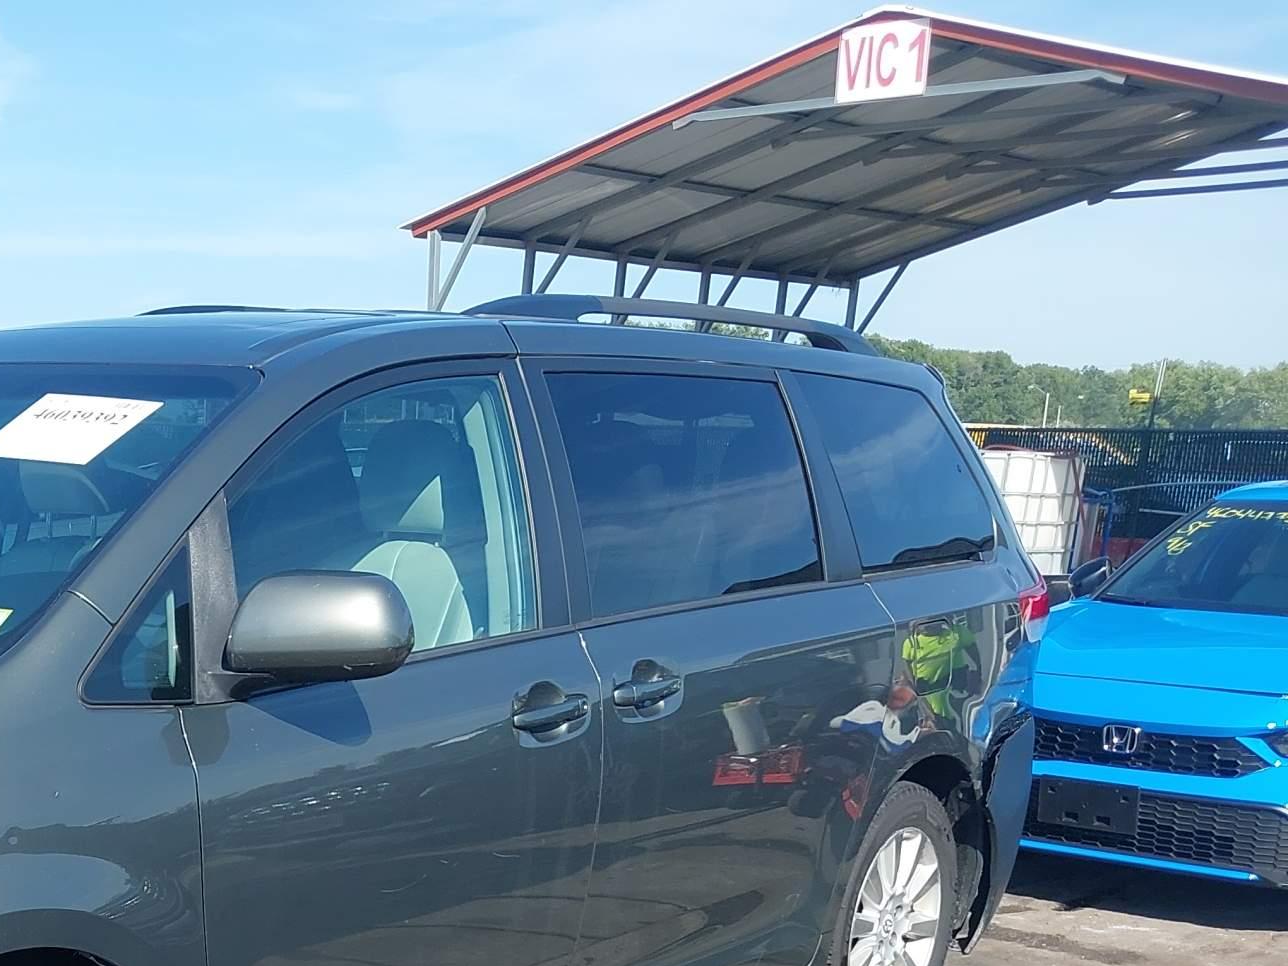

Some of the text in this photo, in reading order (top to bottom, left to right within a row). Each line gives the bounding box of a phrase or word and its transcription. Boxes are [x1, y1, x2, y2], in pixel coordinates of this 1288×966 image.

[842, 28, 928, 91] VIC 1
[33, 408, 128, 425] 46039392
